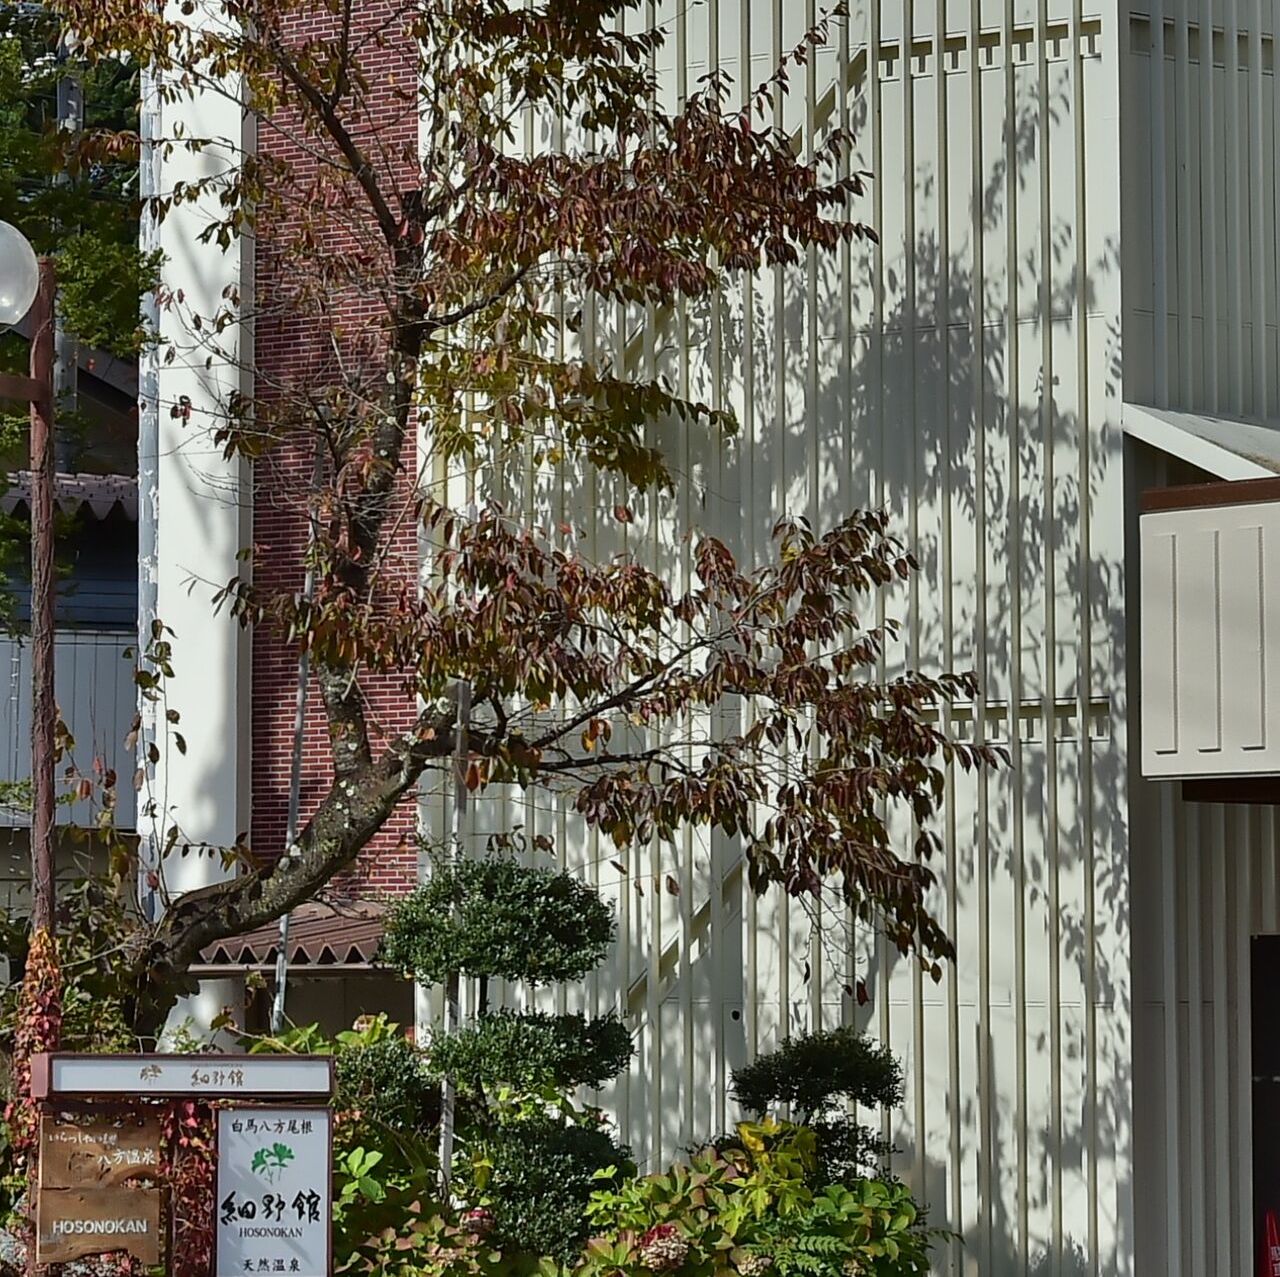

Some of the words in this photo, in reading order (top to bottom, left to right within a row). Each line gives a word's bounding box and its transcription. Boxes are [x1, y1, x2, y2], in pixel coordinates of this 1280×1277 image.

[231, 1118, 314, 1135] 白馬八方尾根
[97, 1147, 157, 1165] 八方温泉
[220, 1189, 322, 1226] 細野館
[52, 1219, 147, 1235] HOSONOKAN
[239, 1227, 303, 1239] HOSONOKAN
[243, 1258, 301, 1273] 天然温泉
